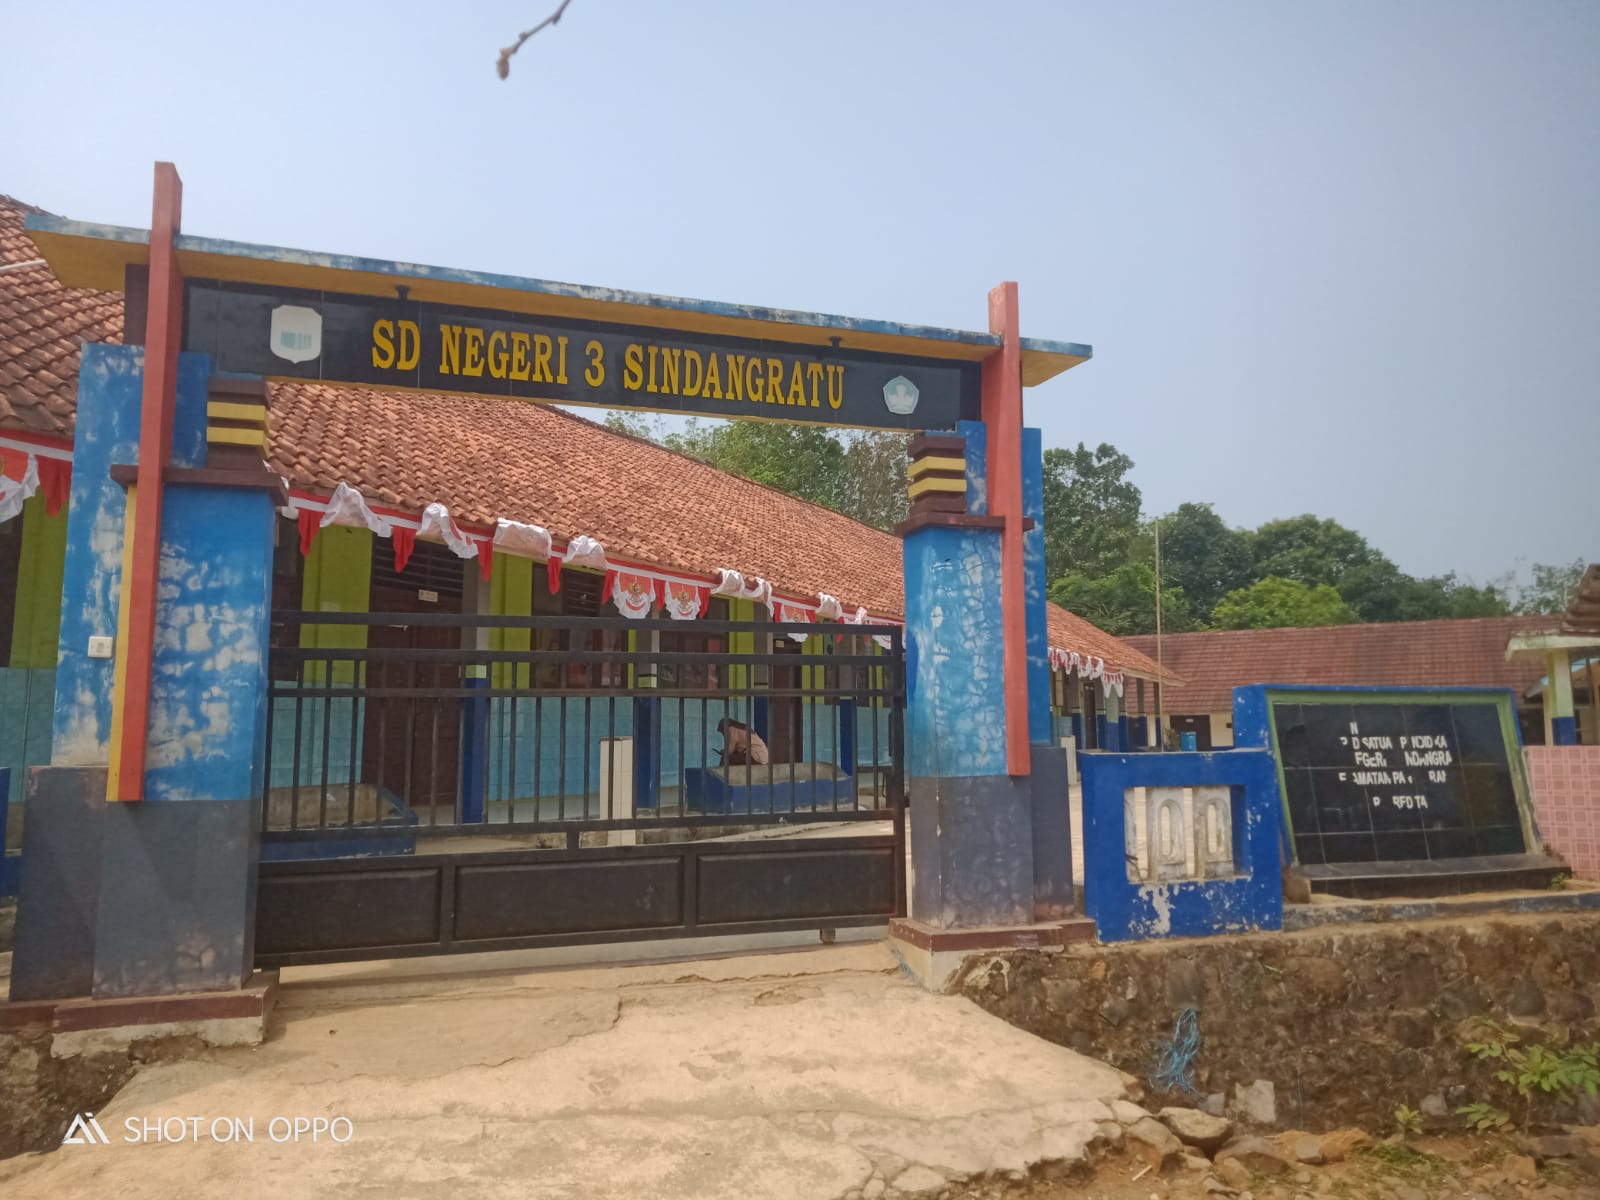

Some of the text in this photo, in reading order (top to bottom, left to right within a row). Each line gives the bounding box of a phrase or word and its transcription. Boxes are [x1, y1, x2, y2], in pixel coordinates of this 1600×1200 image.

[371, 317, 845, 411] SD NEGERI 3 SINDANGRATU
